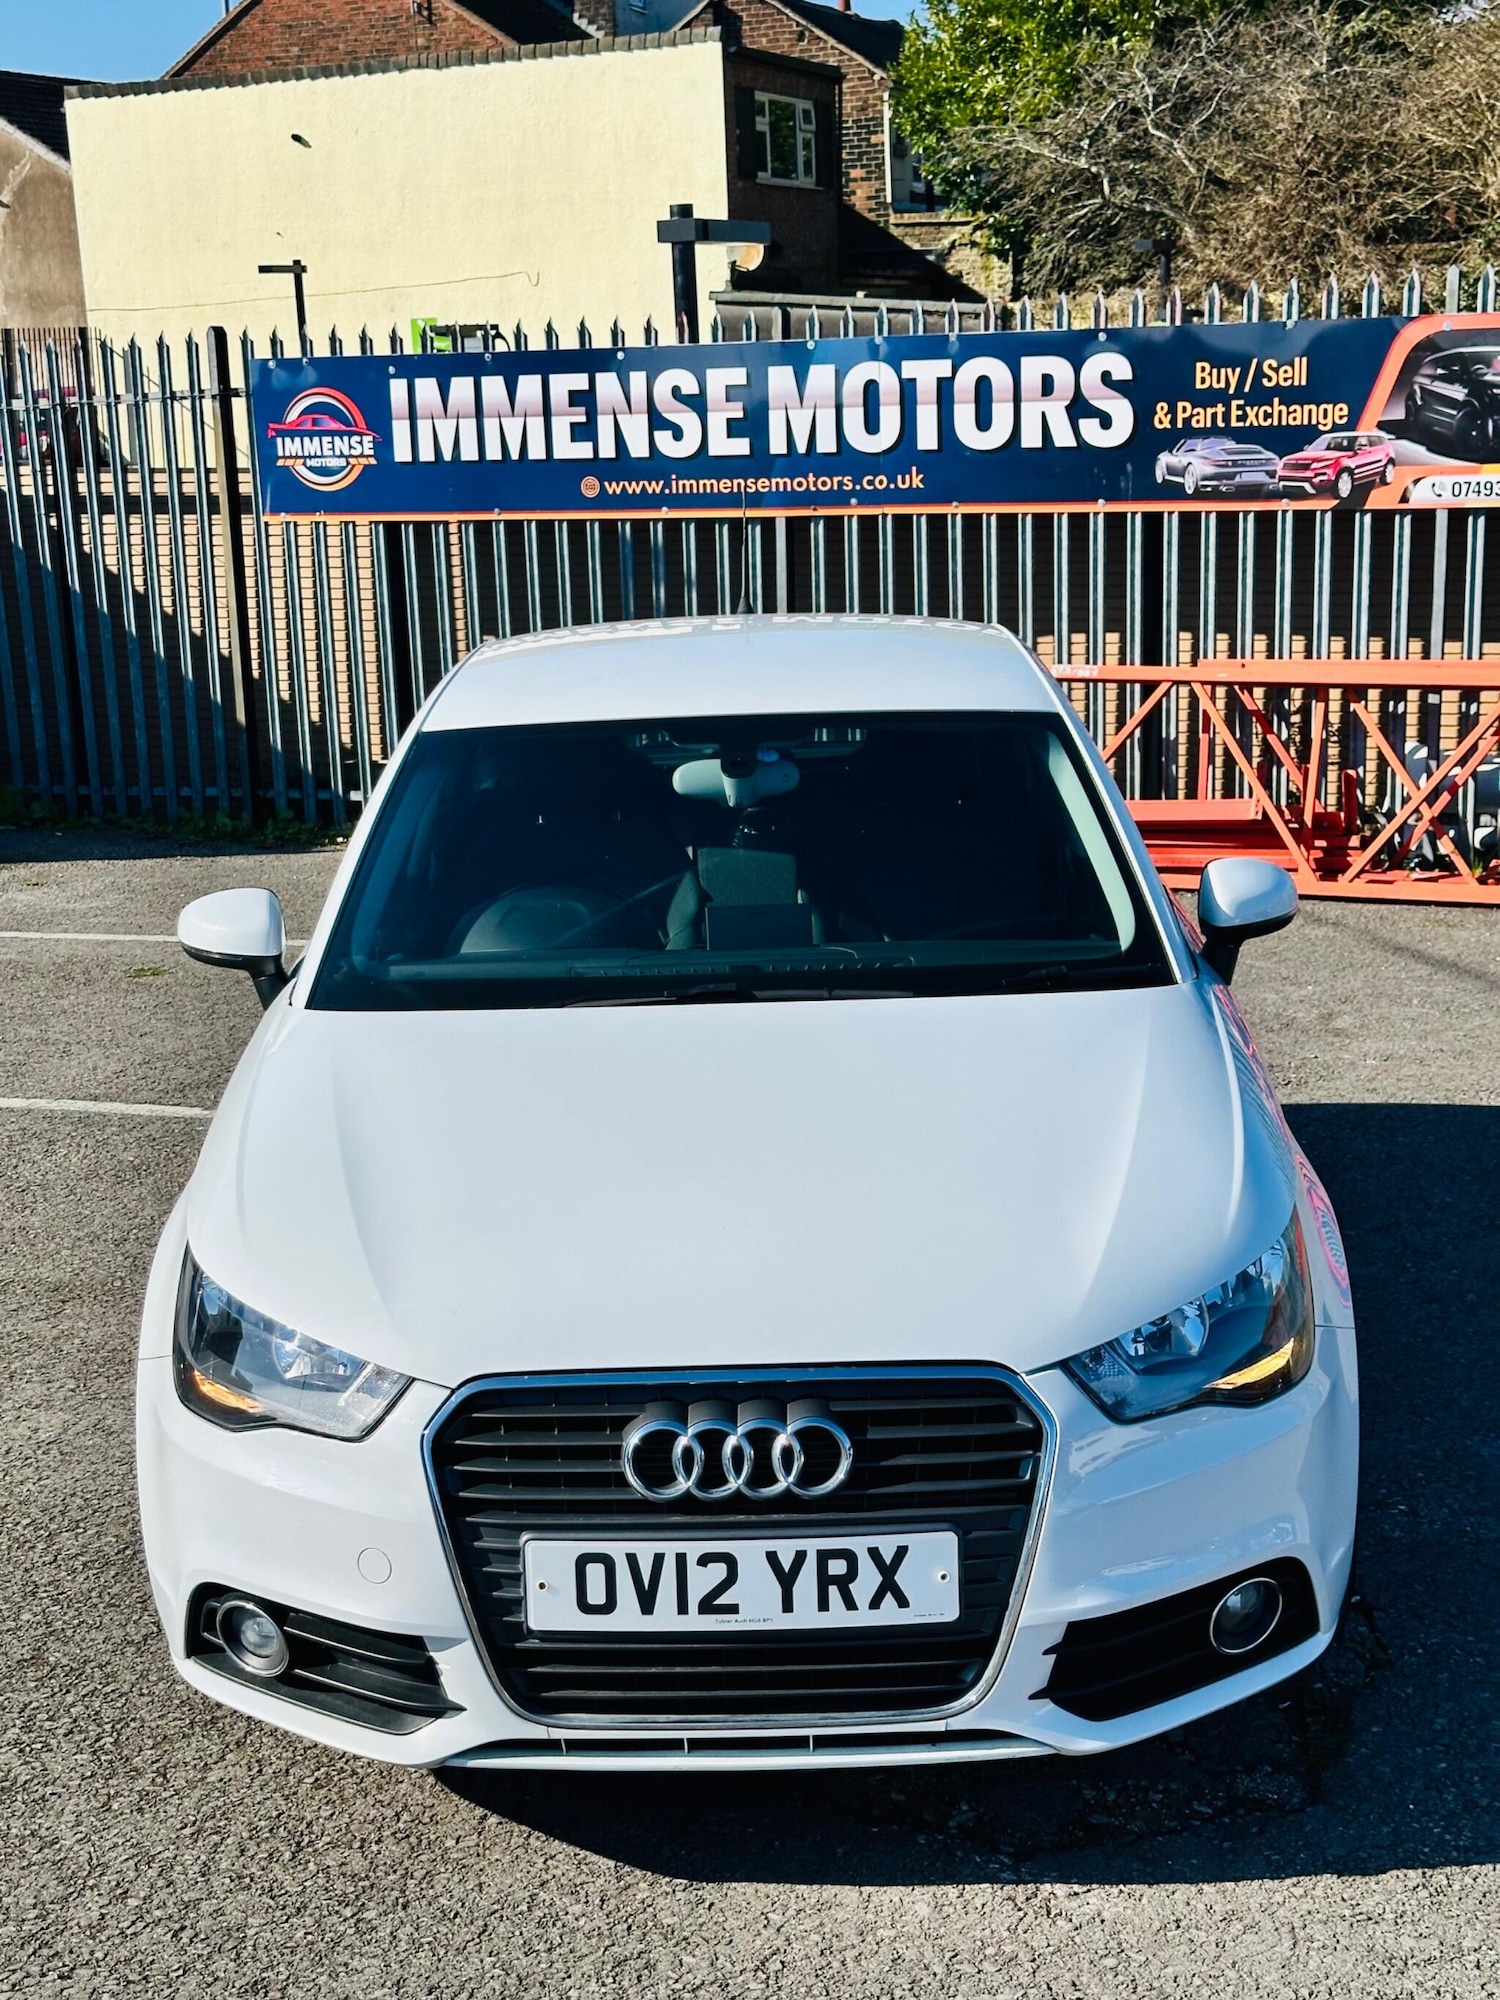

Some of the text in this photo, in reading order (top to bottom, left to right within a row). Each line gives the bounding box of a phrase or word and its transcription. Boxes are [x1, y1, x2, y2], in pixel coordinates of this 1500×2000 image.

[1195, 356, 1308, 394] Buy / Sell
[388, 352, 1135, 463] IMMENSE MOTORS
[1153, 397, 1349, 431] & Part Exchange
[276, 434, 374, 457] IMMENSE
[306, 457, 347, 467] MOTORS
[604, 466, 925, 496] www.immensemotors.co.uk
[574, 1545, 910, 1616] OV12 YRX
